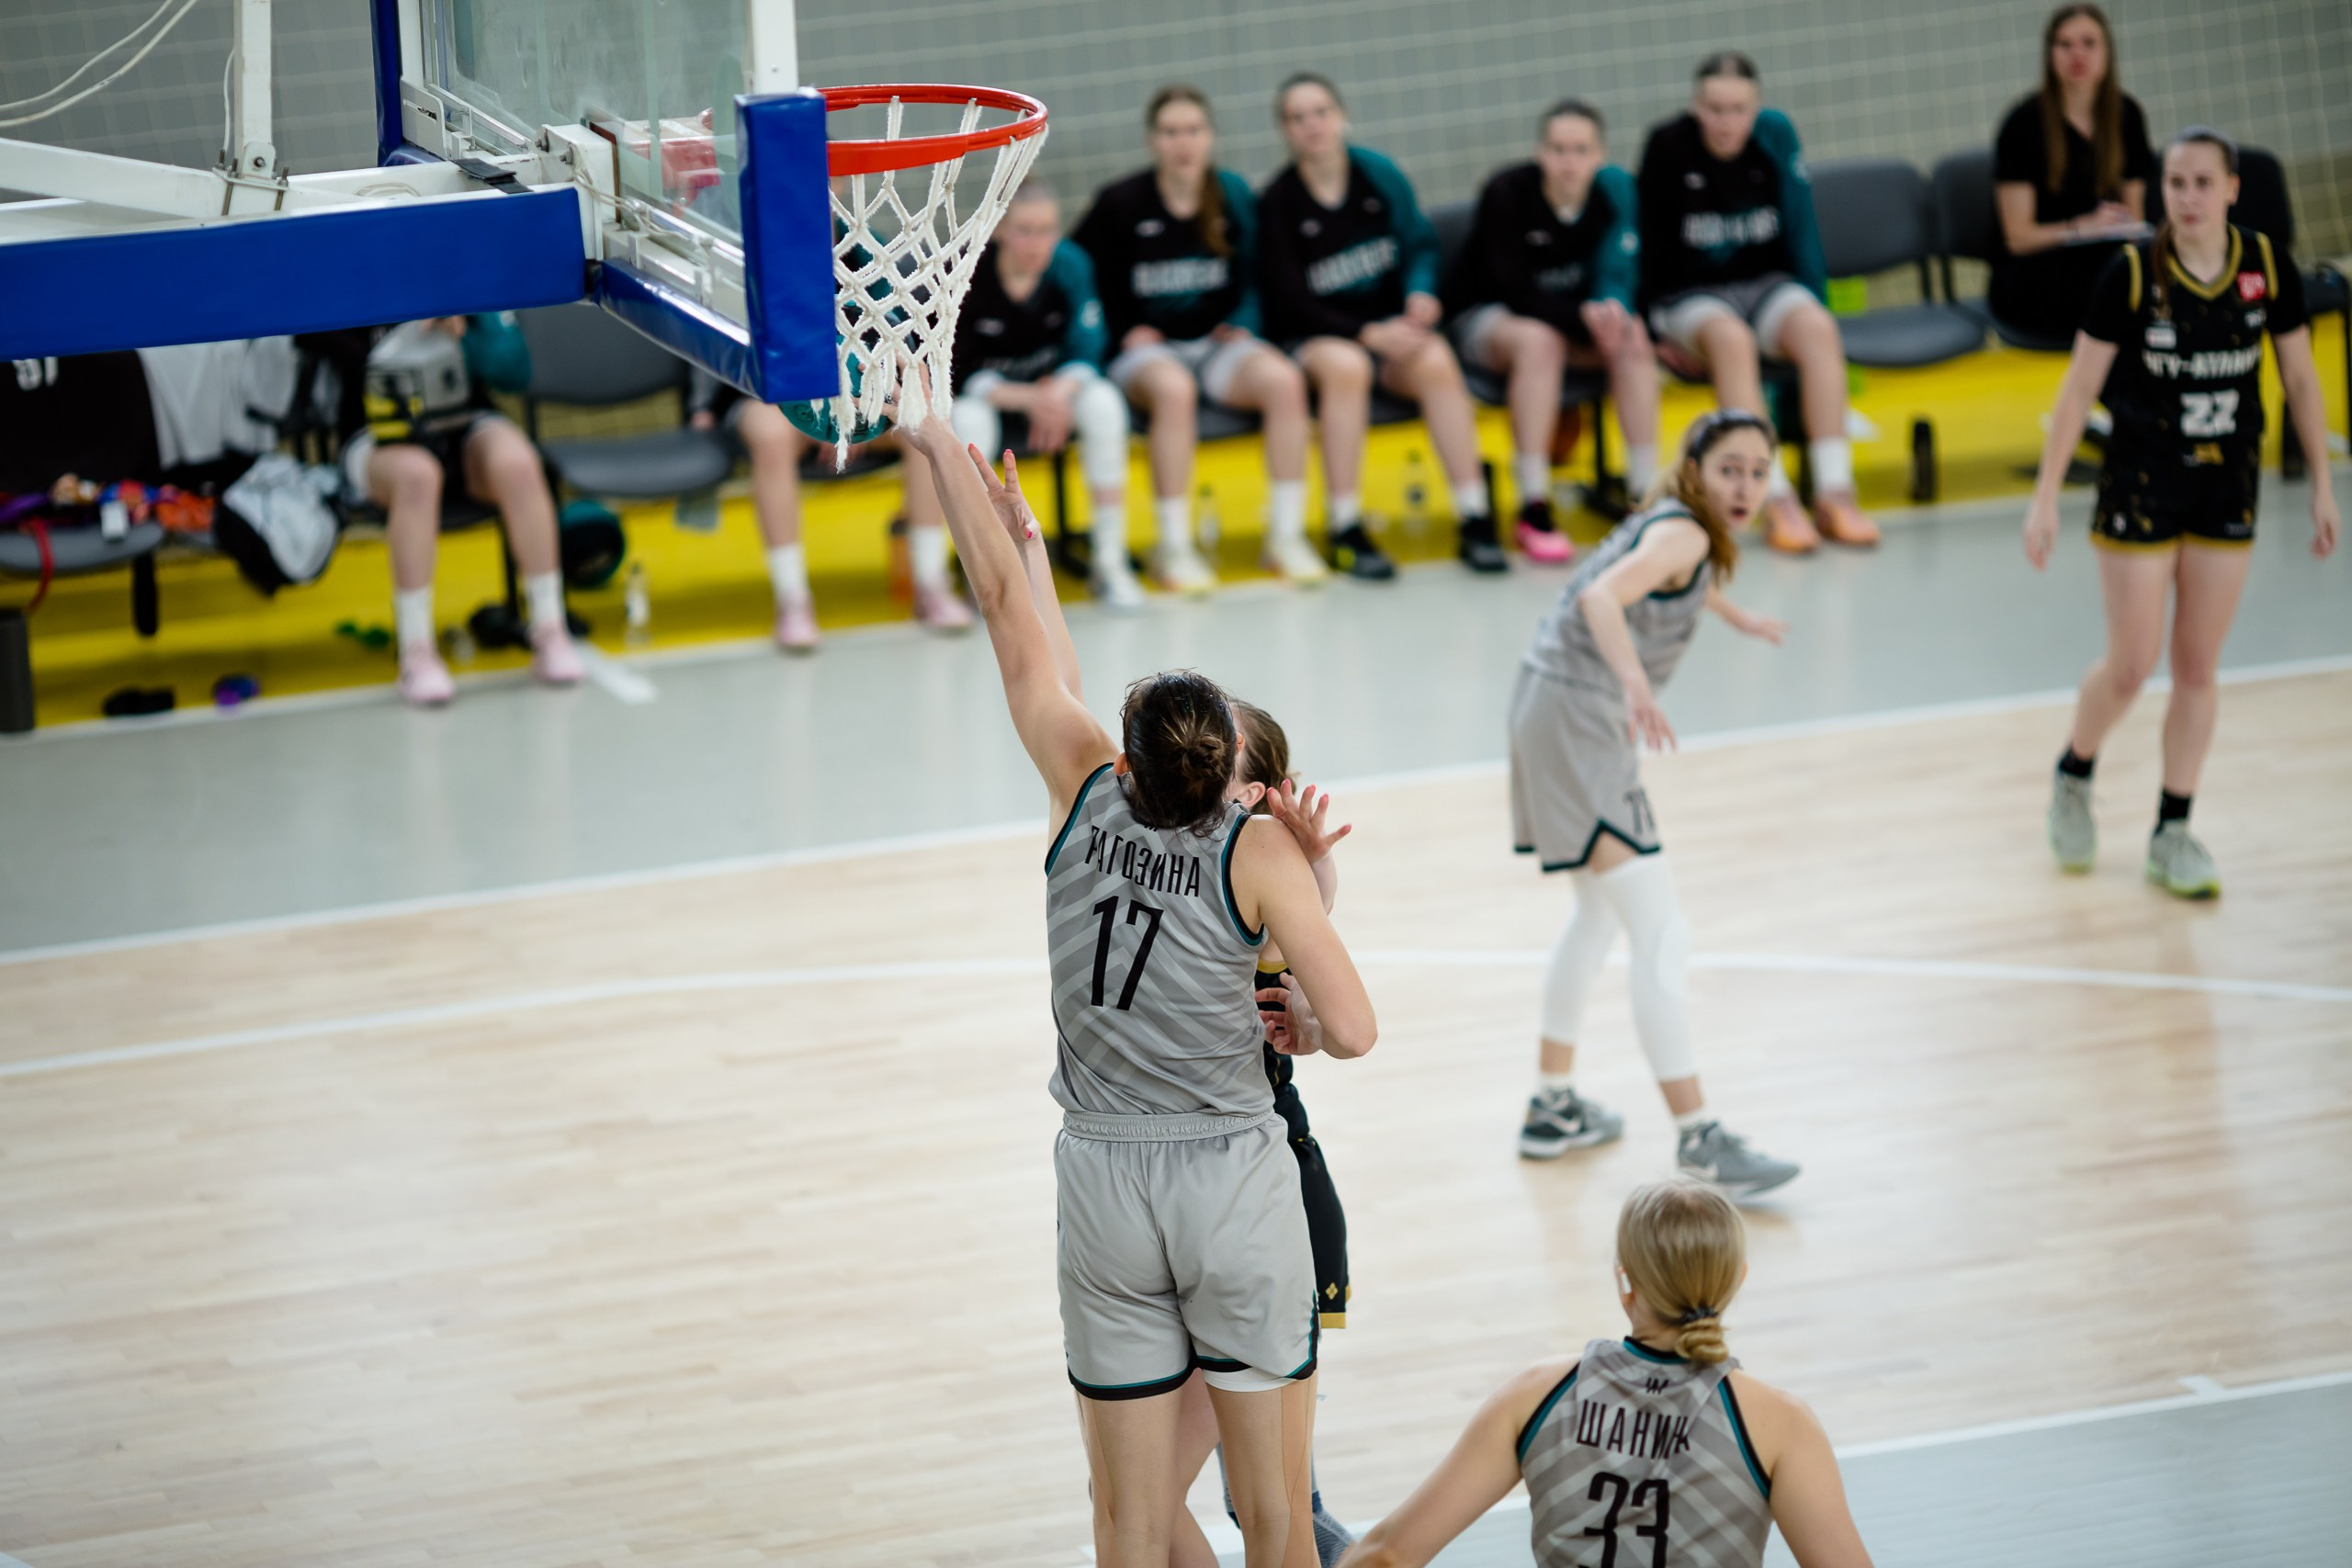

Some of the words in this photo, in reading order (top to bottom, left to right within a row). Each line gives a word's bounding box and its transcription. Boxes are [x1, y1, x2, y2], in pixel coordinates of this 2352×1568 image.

[1085, 825, 1200, 897] РАГОЗИНА
[1091, 896, 1165, 1011] 17
[1577, 1472, 1670, 1568] 33
